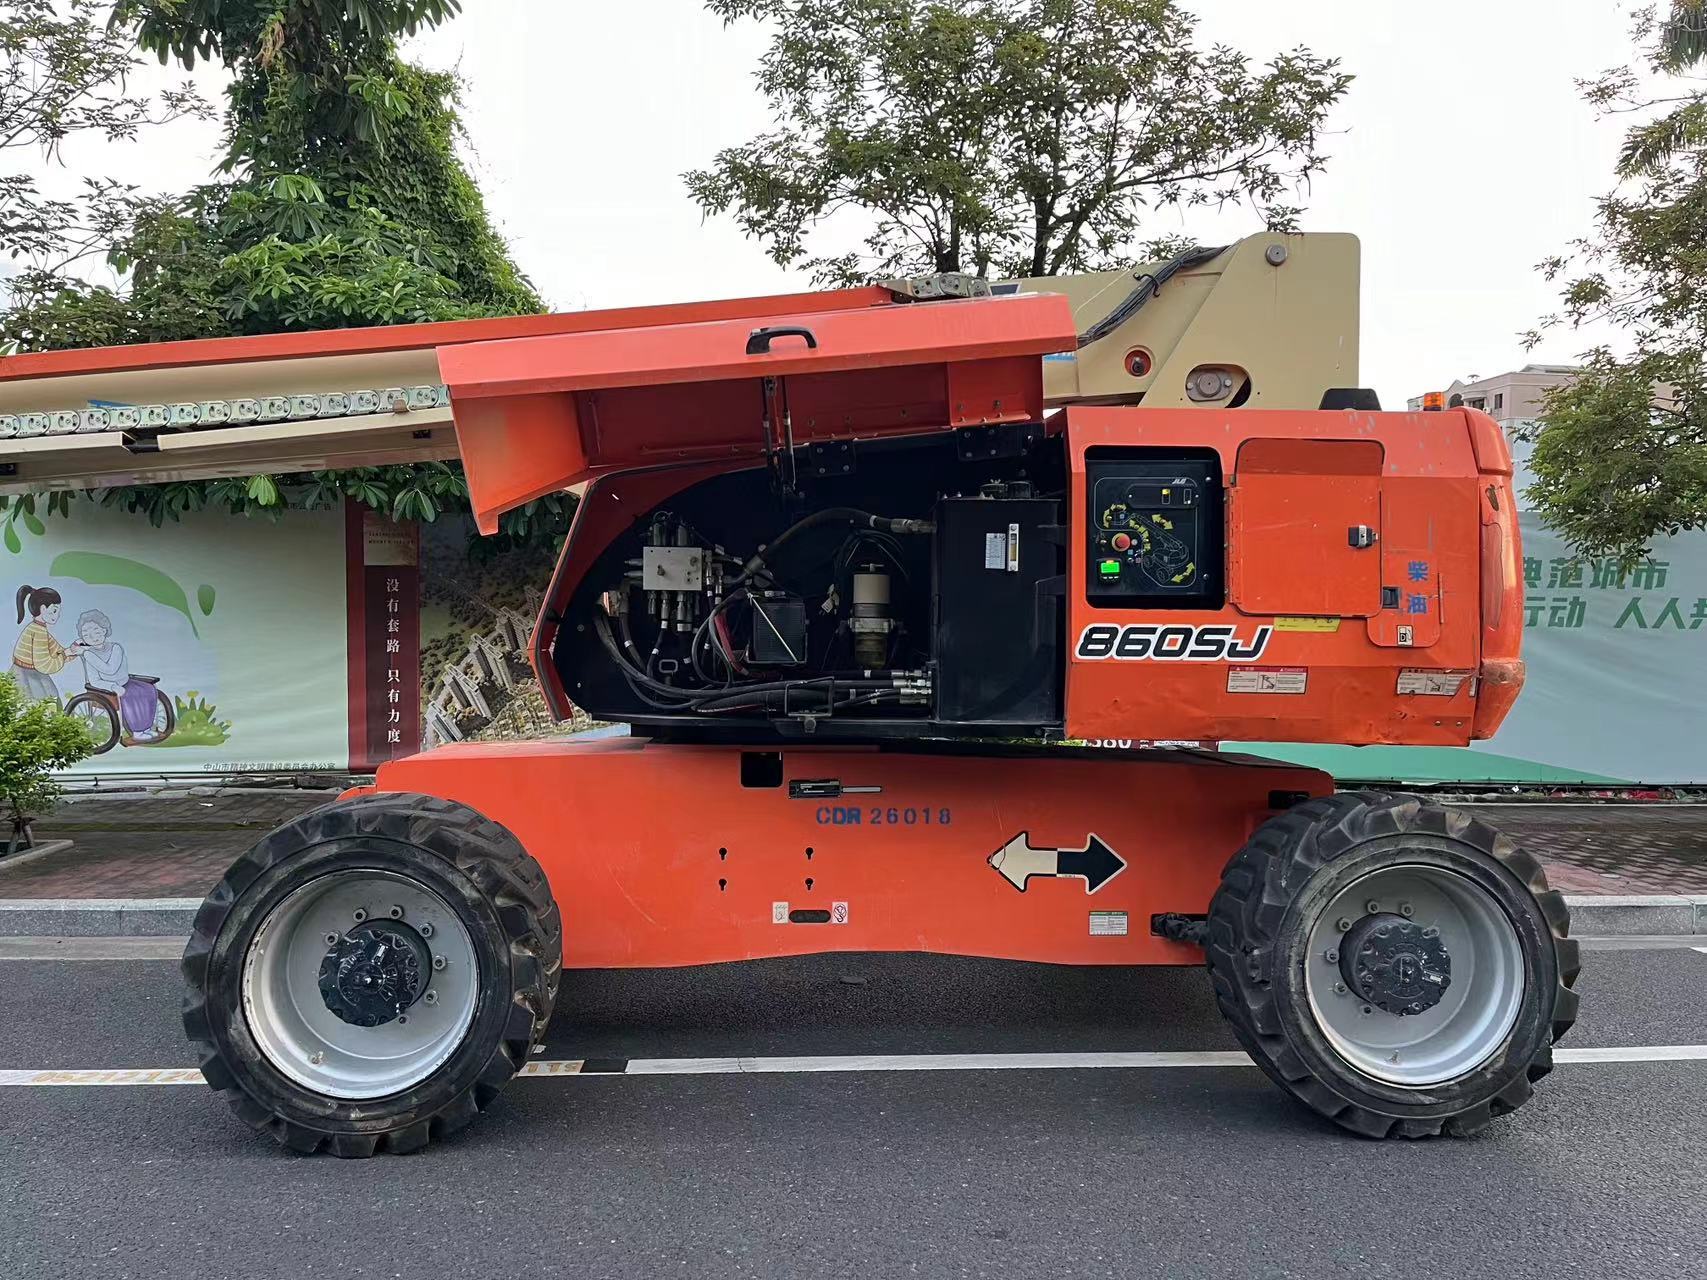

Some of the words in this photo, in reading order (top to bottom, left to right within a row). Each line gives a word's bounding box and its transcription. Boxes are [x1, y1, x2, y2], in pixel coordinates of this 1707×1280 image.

[386, 578, 400, 653] 没有套路
[1076, 624, 1273, 661] 860SJ
[386, 669, 400, 743] 只有力度
[816, 807, 861, 824] CDR
[870, 807, 951, 825] 26018
